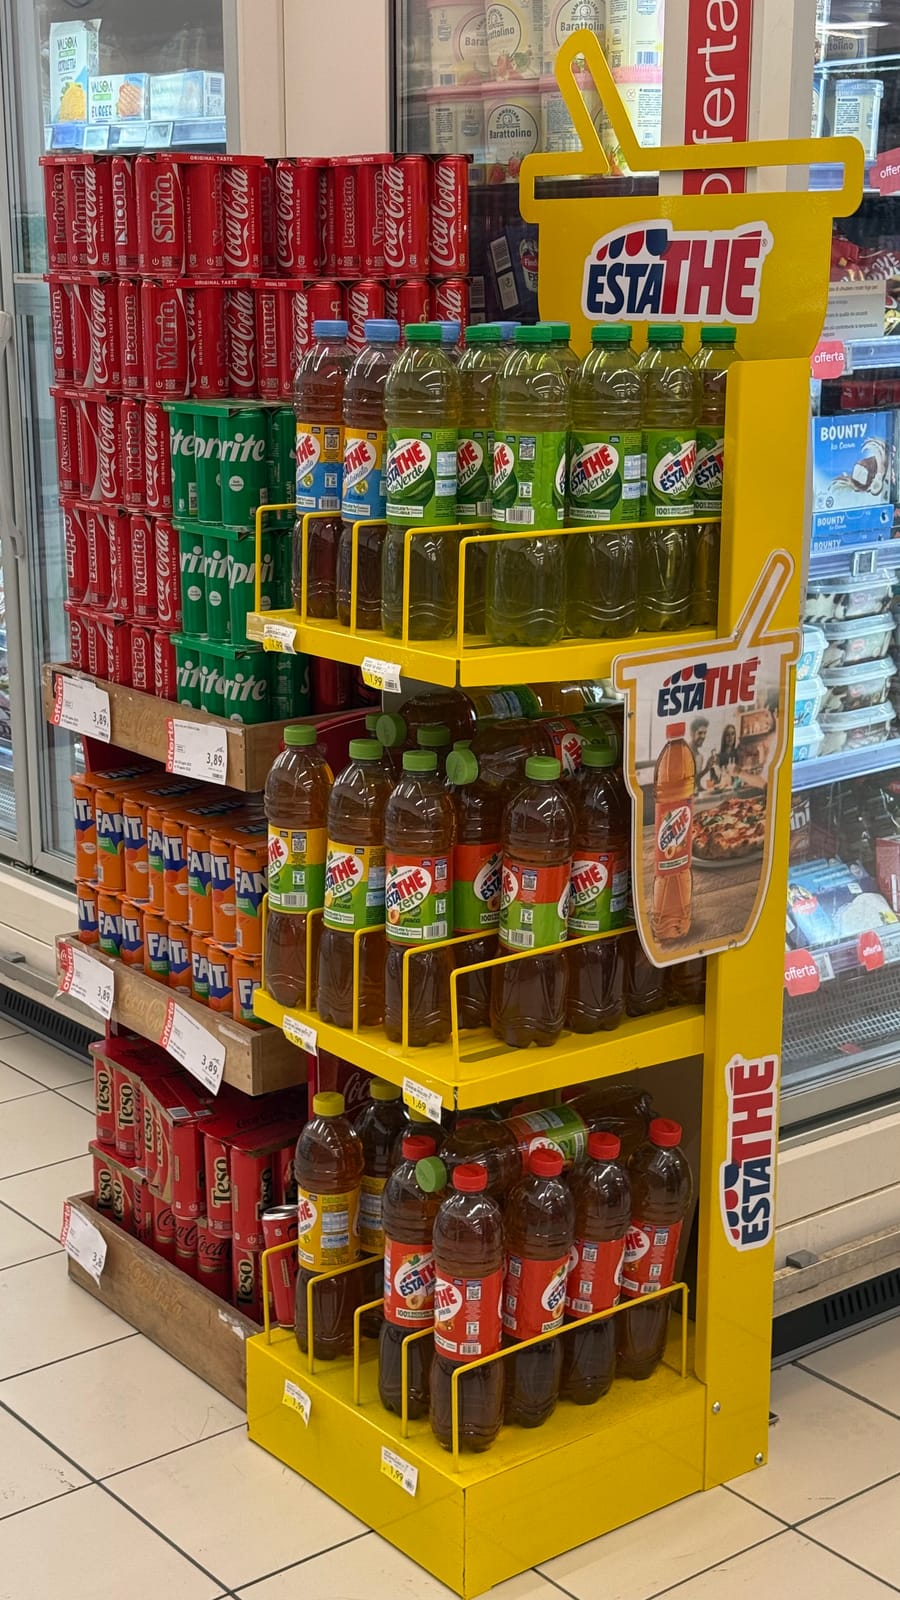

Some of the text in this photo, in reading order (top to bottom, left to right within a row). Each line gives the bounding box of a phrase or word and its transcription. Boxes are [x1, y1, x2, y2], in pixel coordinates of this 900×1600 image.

[880, 164, 900, 179] offer
[113, 172, 128, 246] Nicola
[151, 172, 176, 244] Silvia
[344, 176, 355, 248] Benedetta
[156, 298, 178, 369] Maria
[261, 294, 277, 368] Manuel
[814, 351, 845, 364] offerta
[820, 424, 868, 441] BOUNTY
[125, 410, 142, 481] Michele
[584, 468, 612, 493] Verde
[816, 515, 846, 527] BOUNTY
[134, 530, 148, 596] Matilde
[132, 636, 146, 688] ichele
[206, 752, 222, 767] 3,89
[397, 891, 424, 911] zero
[784, 964, 817, 982] offerta
[202, 1054, 218, 1075] 3,89
